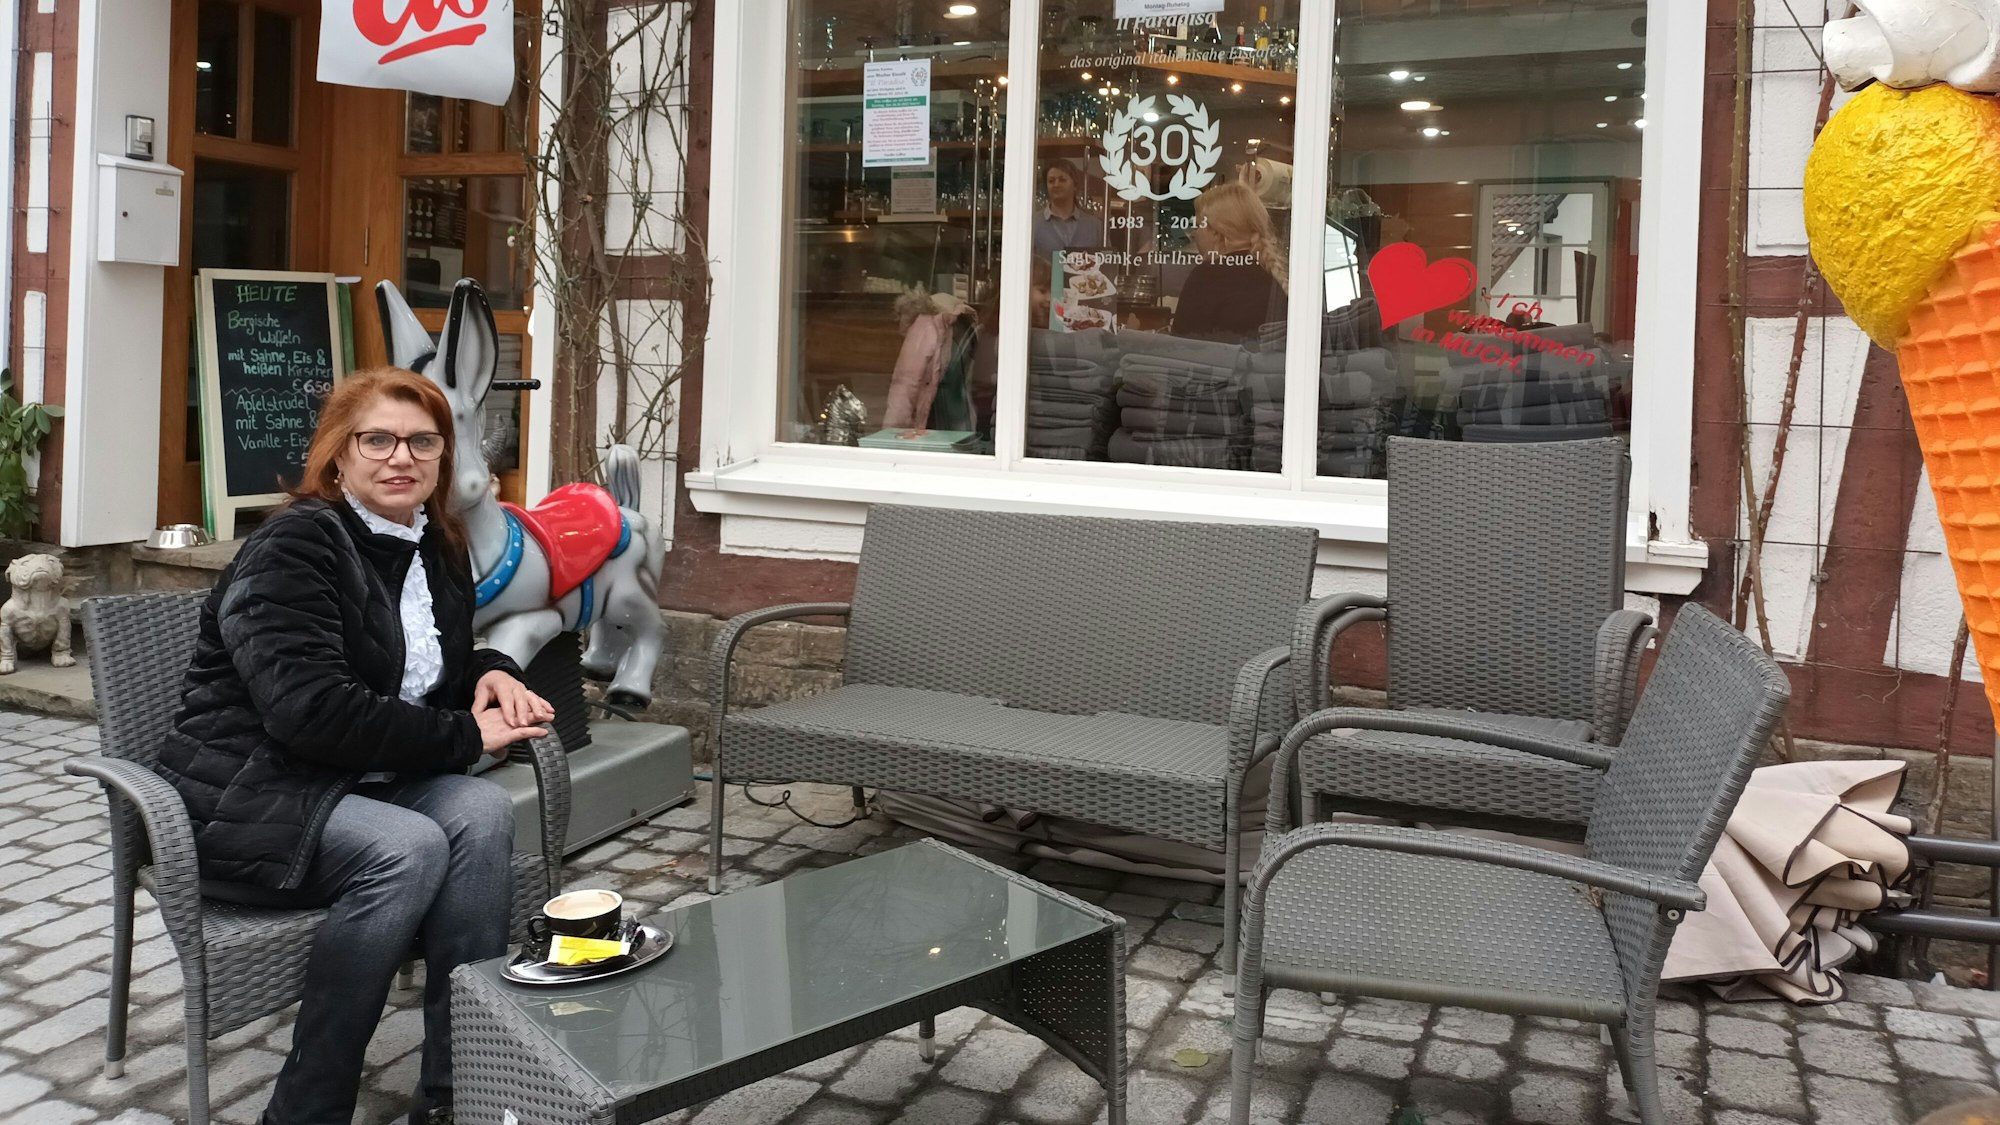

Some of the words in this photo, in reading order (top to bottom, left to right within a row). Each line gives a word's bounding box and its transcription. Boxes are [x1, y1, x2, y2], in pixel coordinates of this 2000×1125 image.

[1070, 55, 1092, 68] das
[1094, 53, 1146, 69] original
[1149, 47, 1225, 64] italienische
[1130, 124, 1189, 166] 30
[1109, 216, 1144, 230] 1983
[1170, 216, 1208, 230] 2013
[1059, 250, 1090, 266] Sagt
[1094, 251, 1143, 267] Danke
[1207, 251, 1260, 267] Treue!
[236, 284, 298, 304] HEUTE
[228, 310, 280, 335] Bergische
[258, 329, 301, 347] Waffeln
[1448, 309, 1596, 367] willkommen
[228, 348, 245, 361] mit
[293, 351, 312, 364] Eis
[316, 348, 326, 366] &
[1411, 326, 1435, 344] in
[1439, 331, 1522, 374] MUCH.
[243, 362, 282, 377] heißen
[235, 392, 311, 415] Apfelstrudel
[235, 414, 258, 430] mit
[265, 413, 304, 430] Sahne
[309, 410, 319, 428] &
